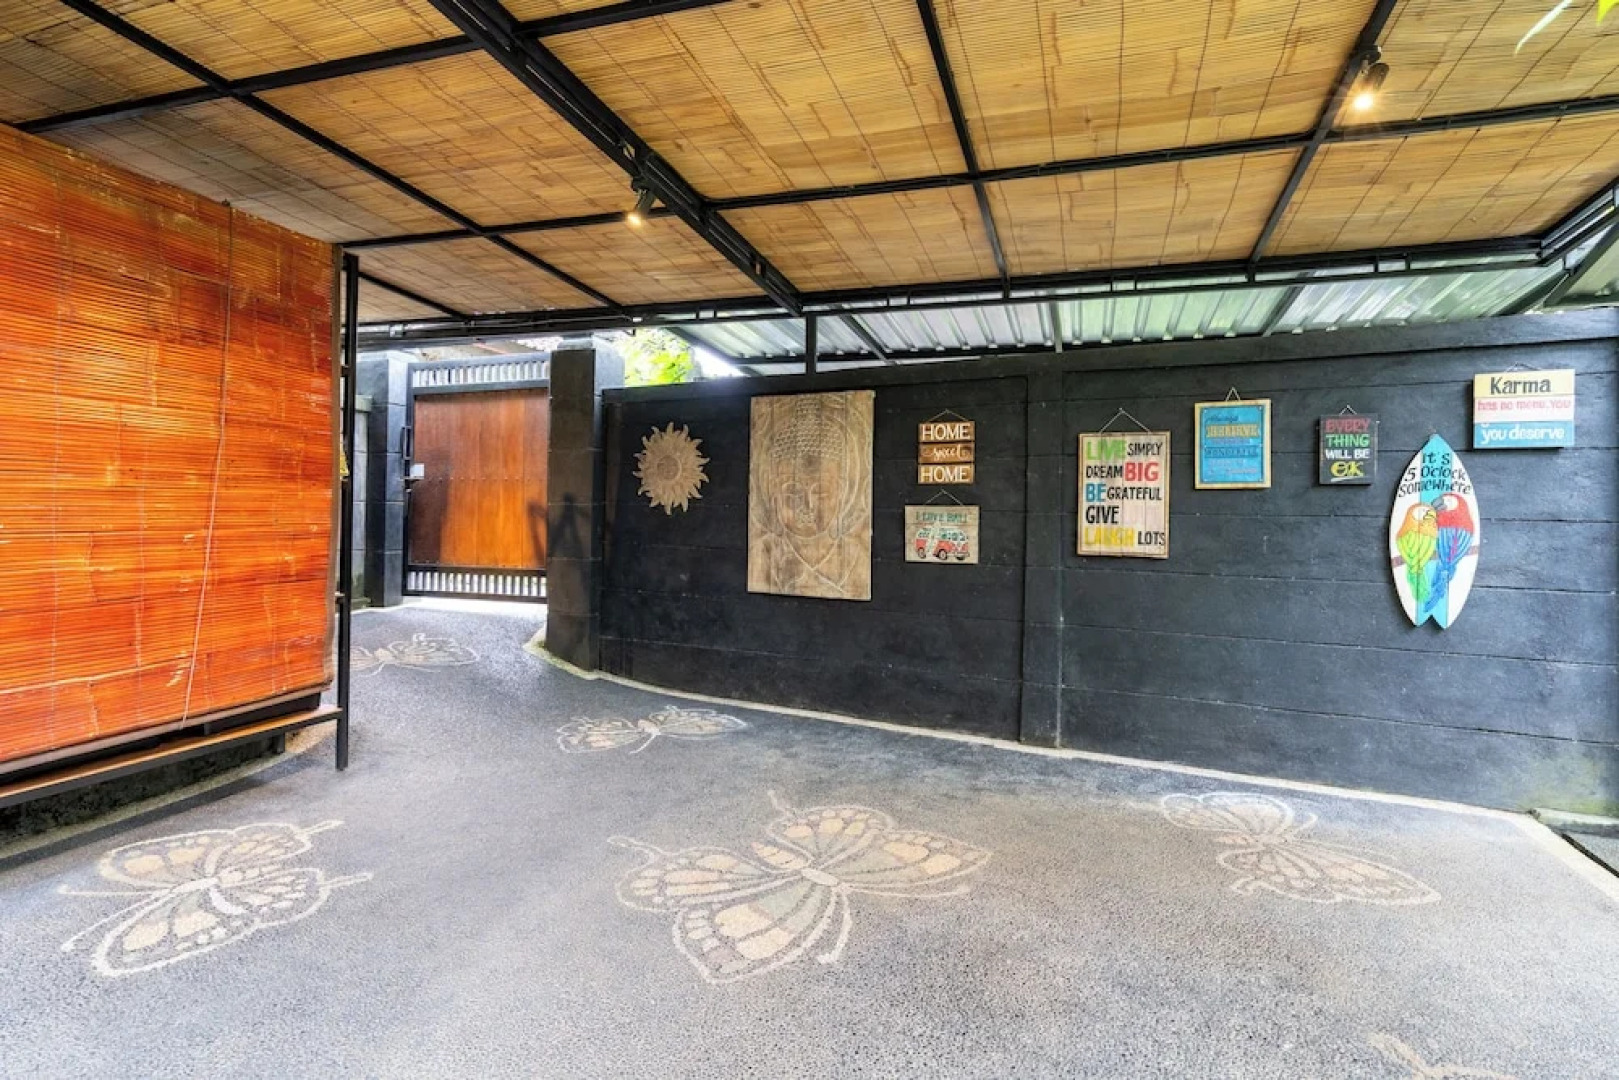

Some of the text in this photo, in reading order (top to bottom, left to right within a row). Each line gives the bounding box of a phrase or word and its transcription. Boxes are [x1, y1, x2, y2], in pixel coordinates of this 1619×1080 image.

[1490, 376, 1552, 395] Karma
[922, 423, 971, 441] HOME
[1325, 418, 1371, 433] EVERY
[1481, 424, 1565, 445] you deserve
[1087, 440, 1163, 460] LIVE SIMPLY
[1325, 434, 1370, 448] THING
[1325, 449, 1370, 459] WILL BE
[920, 466, 971, 482] HOME
[1086, 462, 1159, 481] DREAM BIG
[1330, 461, 1364, 477] OK
[1405, 467, 1417, 482] 5
[1085, 483, 1162, 502] BE GRATEFUL
[1085, 505, 1119, 524] GIVE
[1084, 527, 1166, 547] LAUGH LOTS
